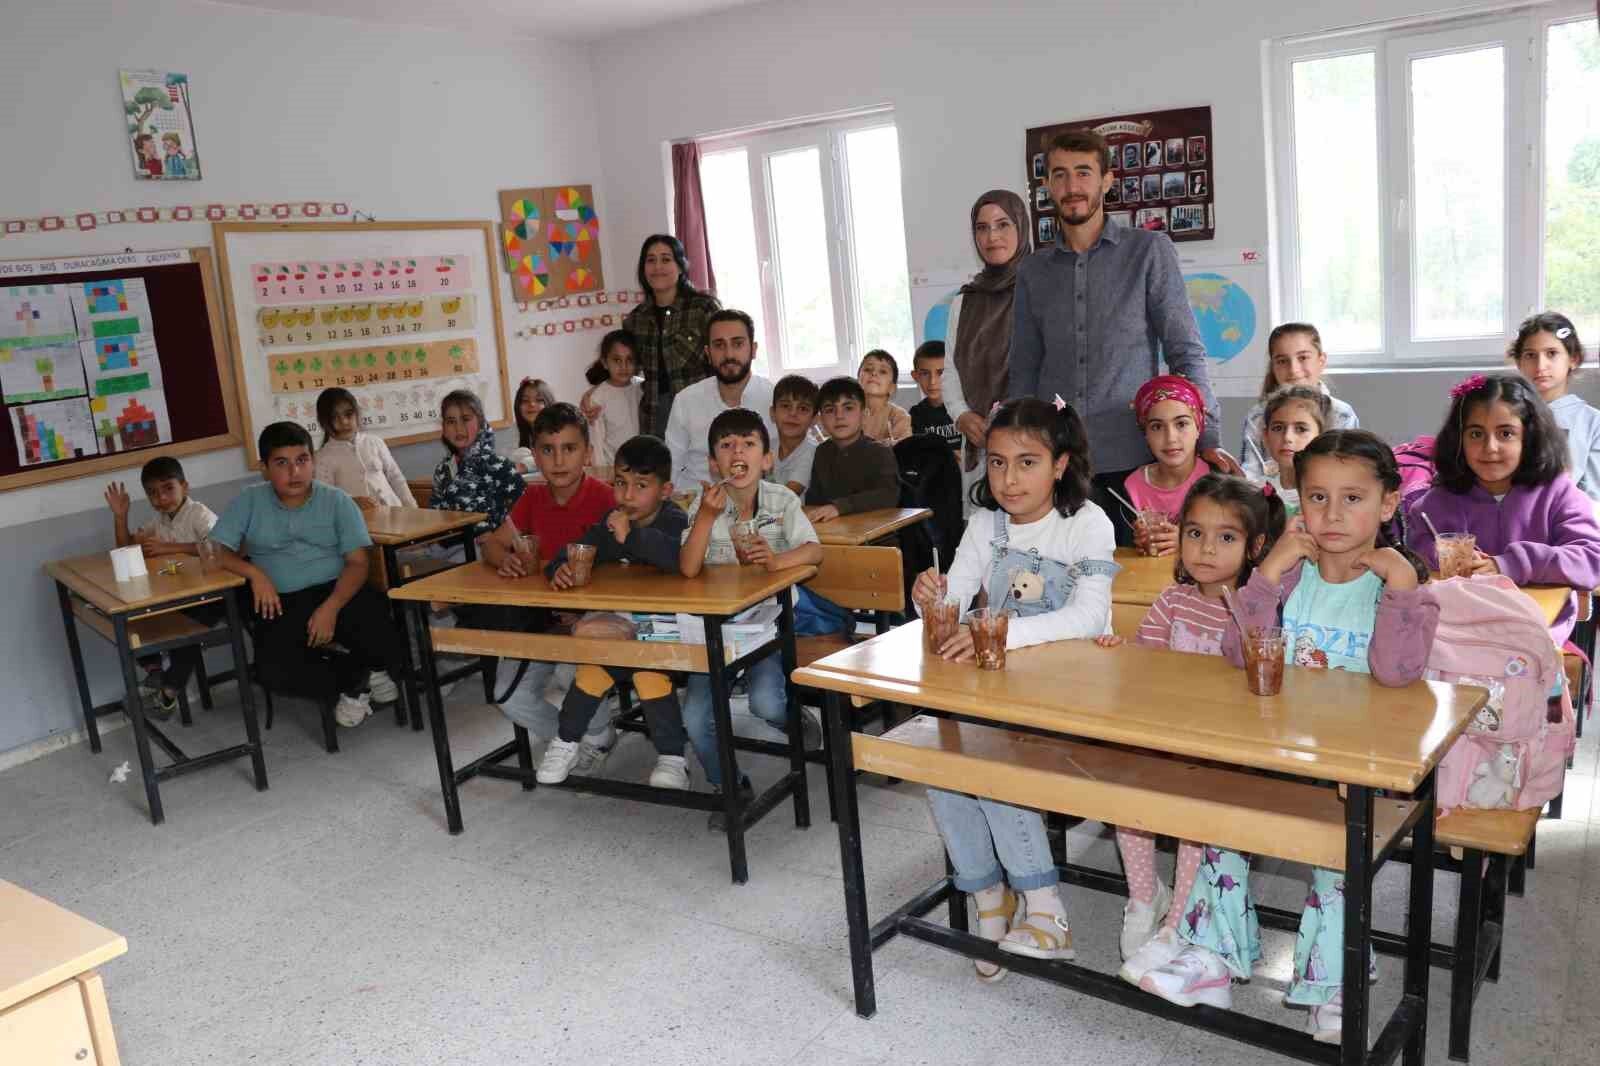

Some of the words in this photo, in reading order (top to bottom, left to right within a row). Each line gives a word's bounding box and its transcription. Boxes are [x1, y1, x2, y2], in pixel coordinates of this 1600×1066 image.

[262, 287, 269, 297] 2
[281, 286, 287, 295] 4
[299, 285, 305, 295] 6
[320, 285, 327, 295] 8
[336, 284, 346, 294] 10
[353, 283, 363, 293] 12
[374, 281, 384, 290] 14
[391, 280, 400, 290] 16
[408, 280, 417, 289] 18
[440, 278, 449, 287] 20
[268, 335, 274, 344] 3
[287, 333, 294, 343] 6
[305, 331, 312, 341] 9
[327, 329, 337, 340] 12
[343, 328, 353, 338] 15
[361, 327, 370, 336] 18
[381, 325, 391, 335] 21
[397, 323, 405, 333] 24
[413, 322, 422, 332] 27
[447, 319, 456, 329] 30
[282, 381, 289, 391] 4
[298, 380, 305, 390] 8
[313, 378, 324, 388] 12
[353, 375, 364, 385] 20
[369, 373, 379, 382] 24
[387, 371, 396, 380] 28
[403, 369, 413, 378] 32
[307, 423, 317, 433] 10
[362, 416, 373, 426] 25
[400, 412, 409, 423] 35
[414, 409, 423, 420] 40
[428, 408, 437, 419] 45
